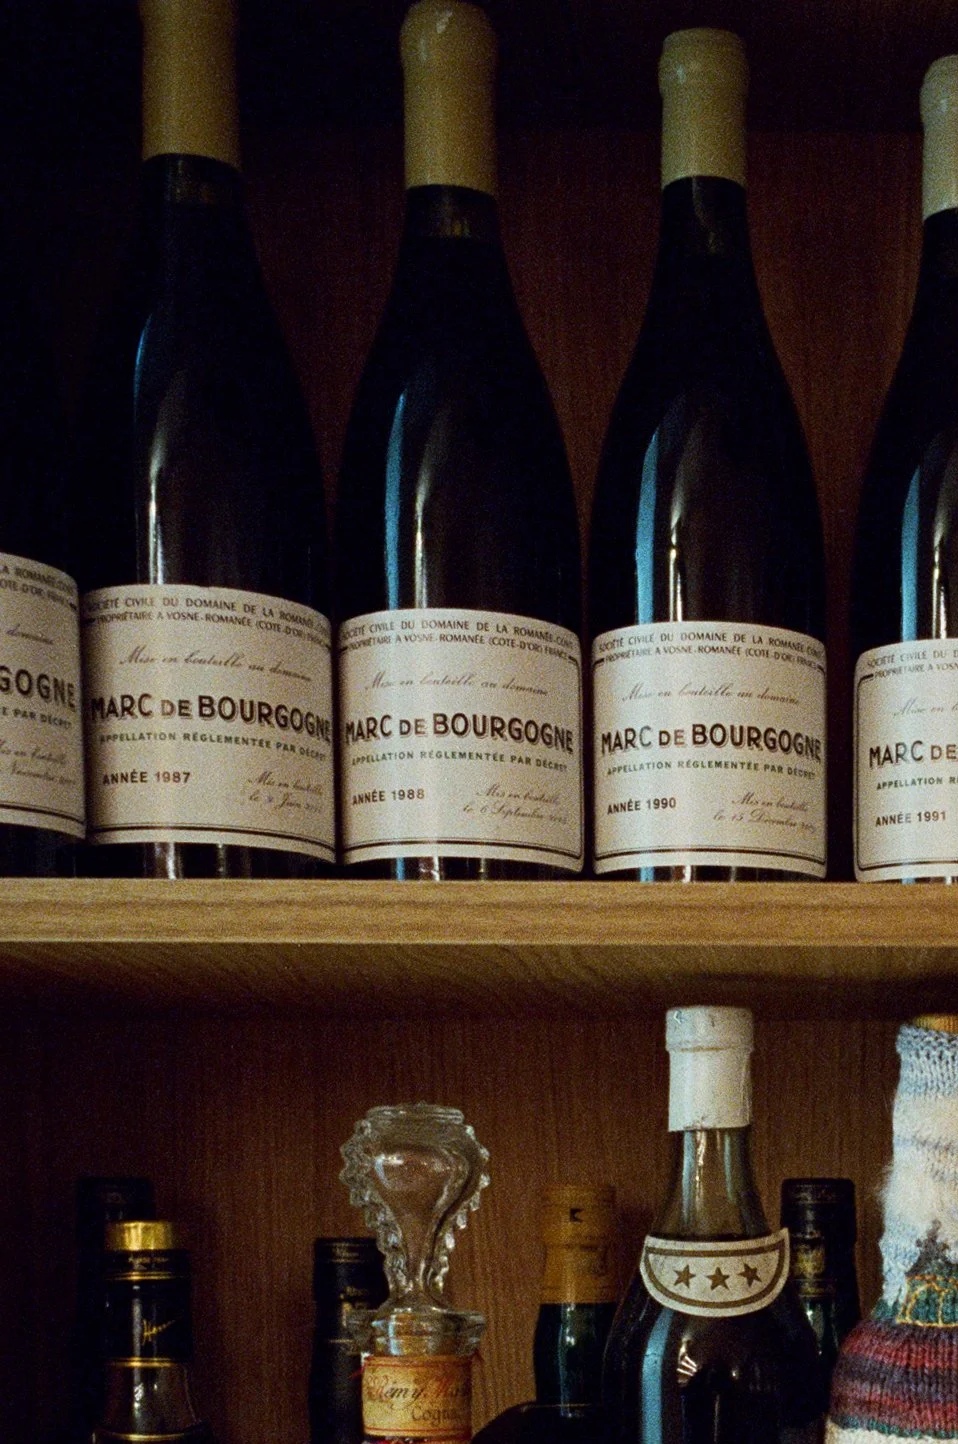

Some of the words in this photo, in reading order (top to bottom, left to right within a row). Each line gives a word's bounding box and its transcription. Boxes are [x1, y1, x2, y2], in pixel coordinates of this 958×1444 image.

[401, 620, 415, 630] DU
[421, 619, 470, 631] DOMAINE
[476, 621, 490, 632] DE
[496, 624, 508, 635] LA
[92, 694, 153, 719] MARC
[161, 700, 191, 717] DE
[198, 695, 331, 742] BOURGOGNE
[183, 731, 271, 749] RÉGLEMENTÉE
[276, 741, 296, 752] PAR
[345, 714, 393, 744] MARC
[400, 718, 427, 736] DE
[432, 712, 574, 754] BOURGOGNE
[601, 725, 653, 755] MARC
[658, 729, 686, 747] DE
[691, 723, 823, 764] BOURGOGNE
[352, 750, 414, 766] APPELLATION
[420, 750, 505, 763] RÉGLEMENTÉE
[510, 755, 532, 767] PAR
[869, 740, 925, 769] MARC
[930, 744, 958, 761] DE
[103, 768, 148, 785] ANNÉE
[154, 771, 191, 784] 1987
[607, 760, 672, 776] APPELLATION
[677, 759, 760, 772] RÉGLEMENTÉE
[763, 763, 784, 774] PAR
[876, 776, 944, 791] APPELLATION
[352, 788, 386, 806] ANNÉE
[391, 788, 425, 801] 1988
[607, 798, 642, 816] ANNÉE
[646, 797, 677, 811] 1990
[875, 811, 912, 828] ANNÉE
[916, 810, 947, 823] 1991
